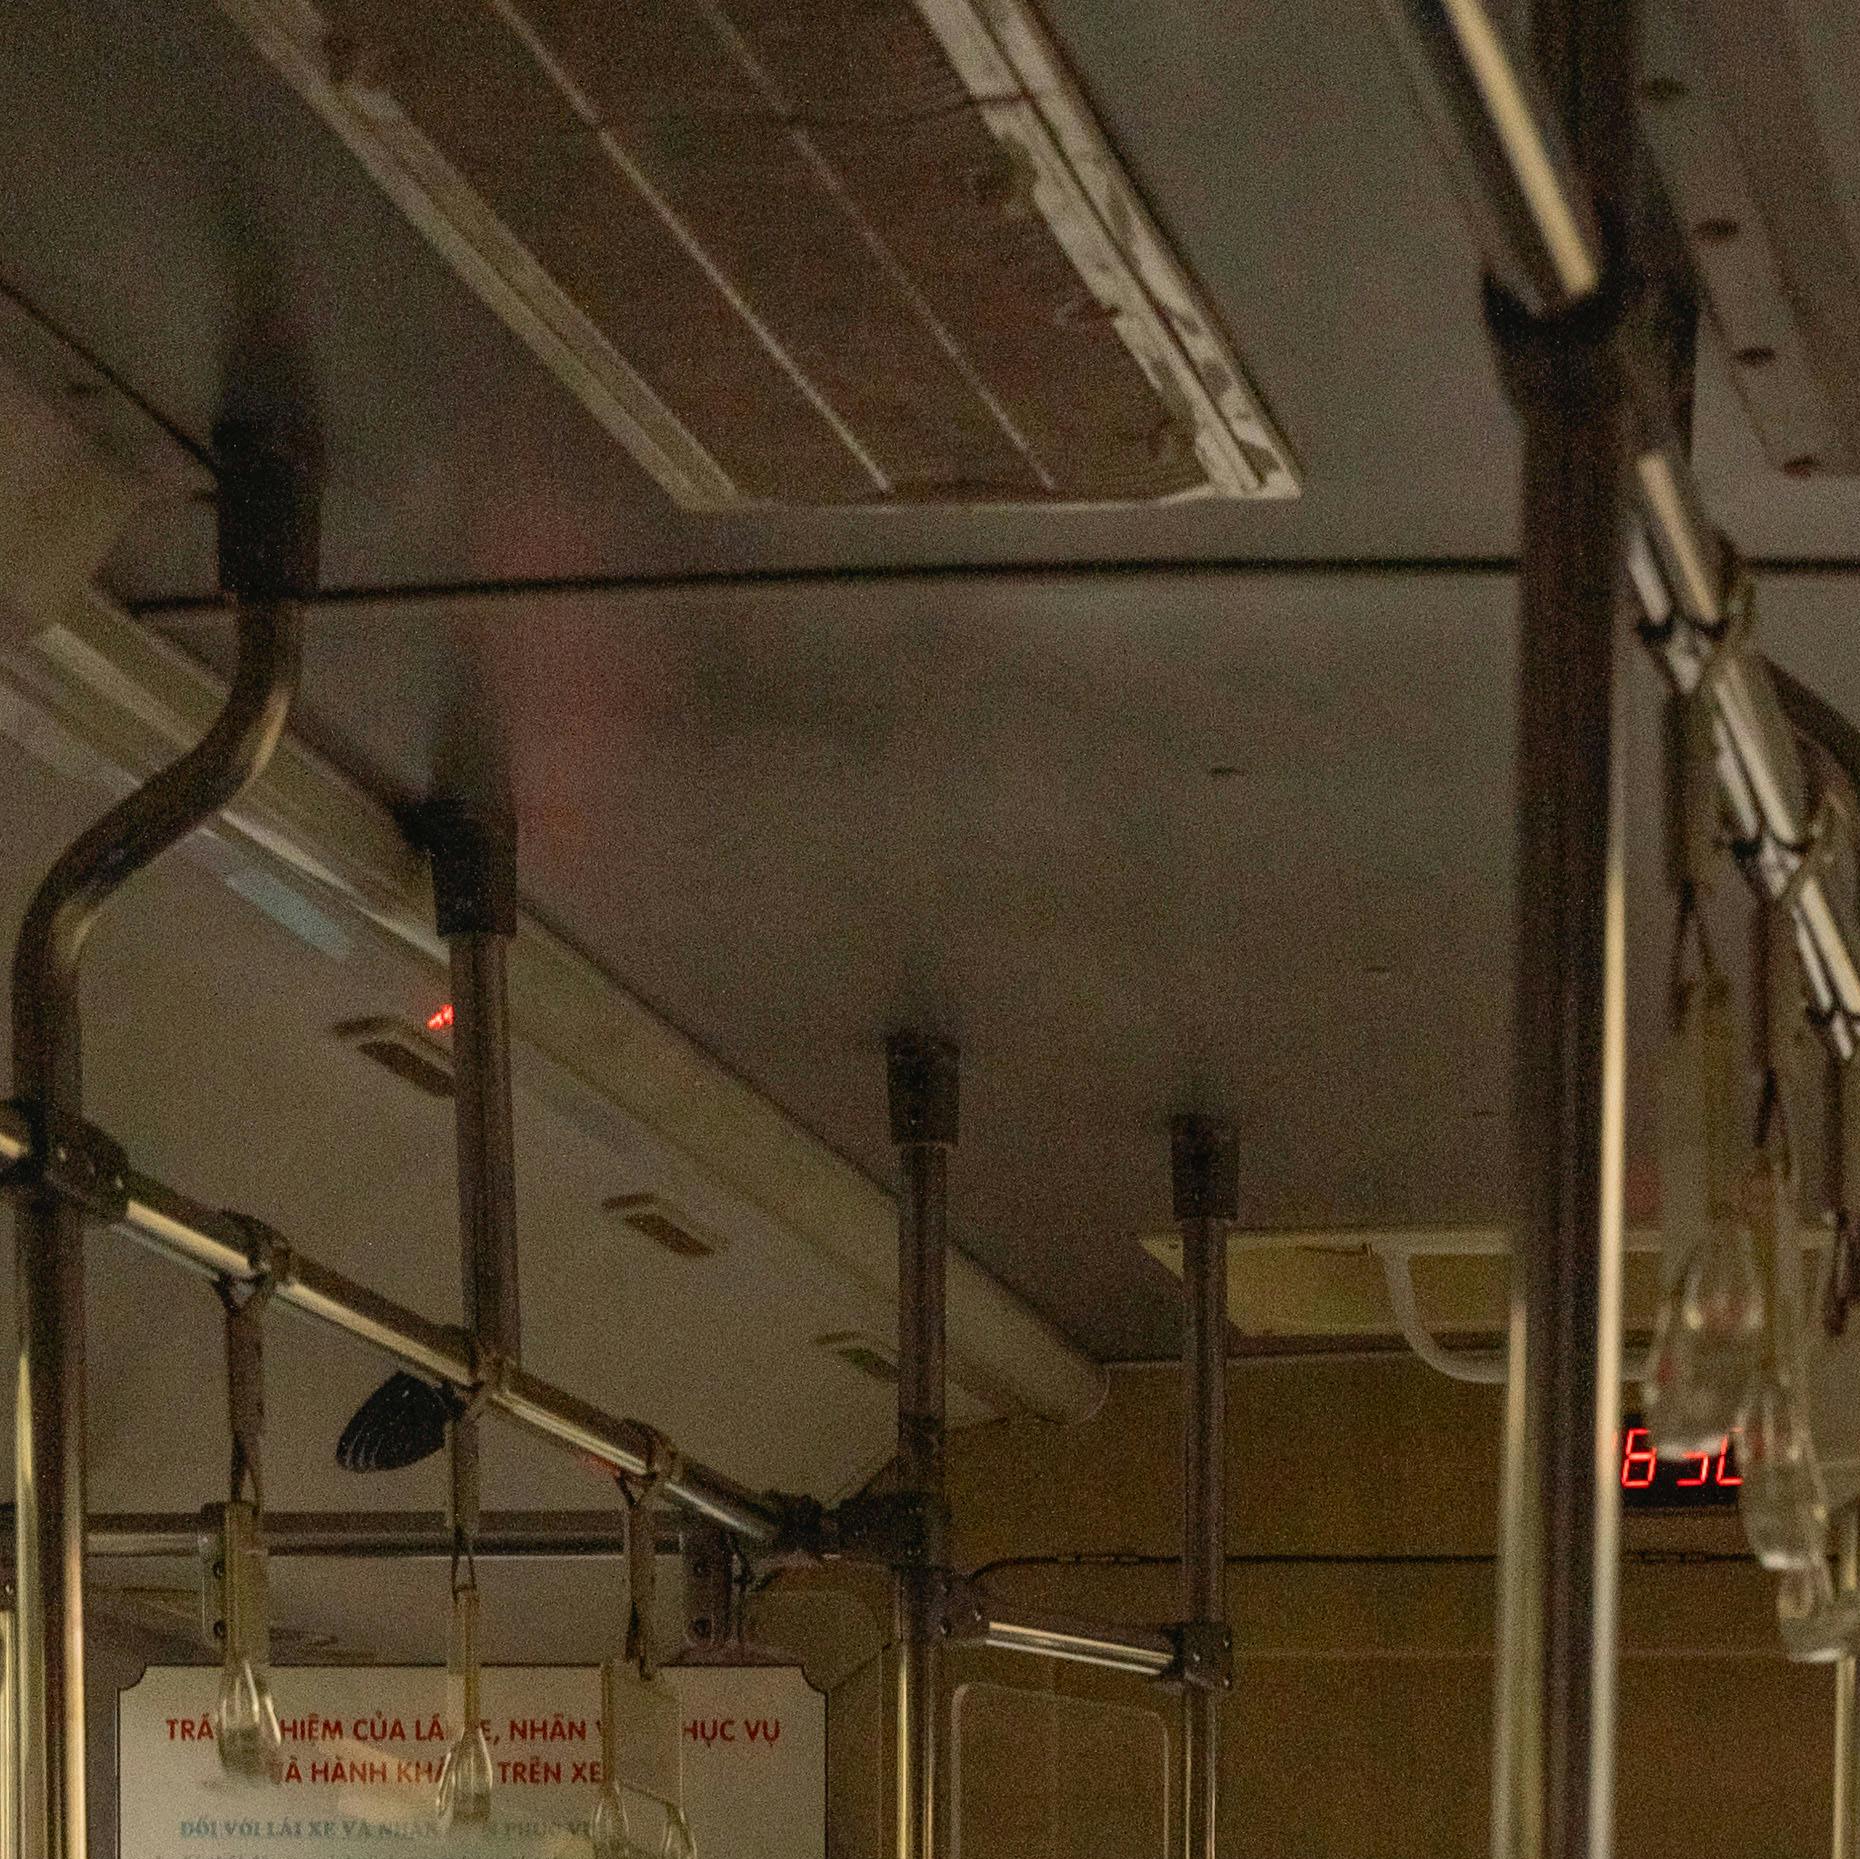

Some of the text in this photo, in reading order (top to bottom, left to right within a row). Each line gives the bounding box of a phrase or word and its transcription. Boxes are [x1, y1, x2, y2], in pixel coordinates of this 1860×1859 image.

[279, 1712, 342, 1746] HIỆM
[353, 1711, 406, 1741] CỦA
[415, 1713, 444, 1741] LÁ
[509, 1713, 586, 1741] NHÂN
[683, 1720, 735, 1748] HỤC
[744, 1720, 780, 1748] VỤ
[311, 1756, 387, 1783] HÀNH
[397, 1754, 444, 1783] KHÁ
[497, 1756, 561, 1783] TRÊN
[572, 1762, 604, 1783] XE
